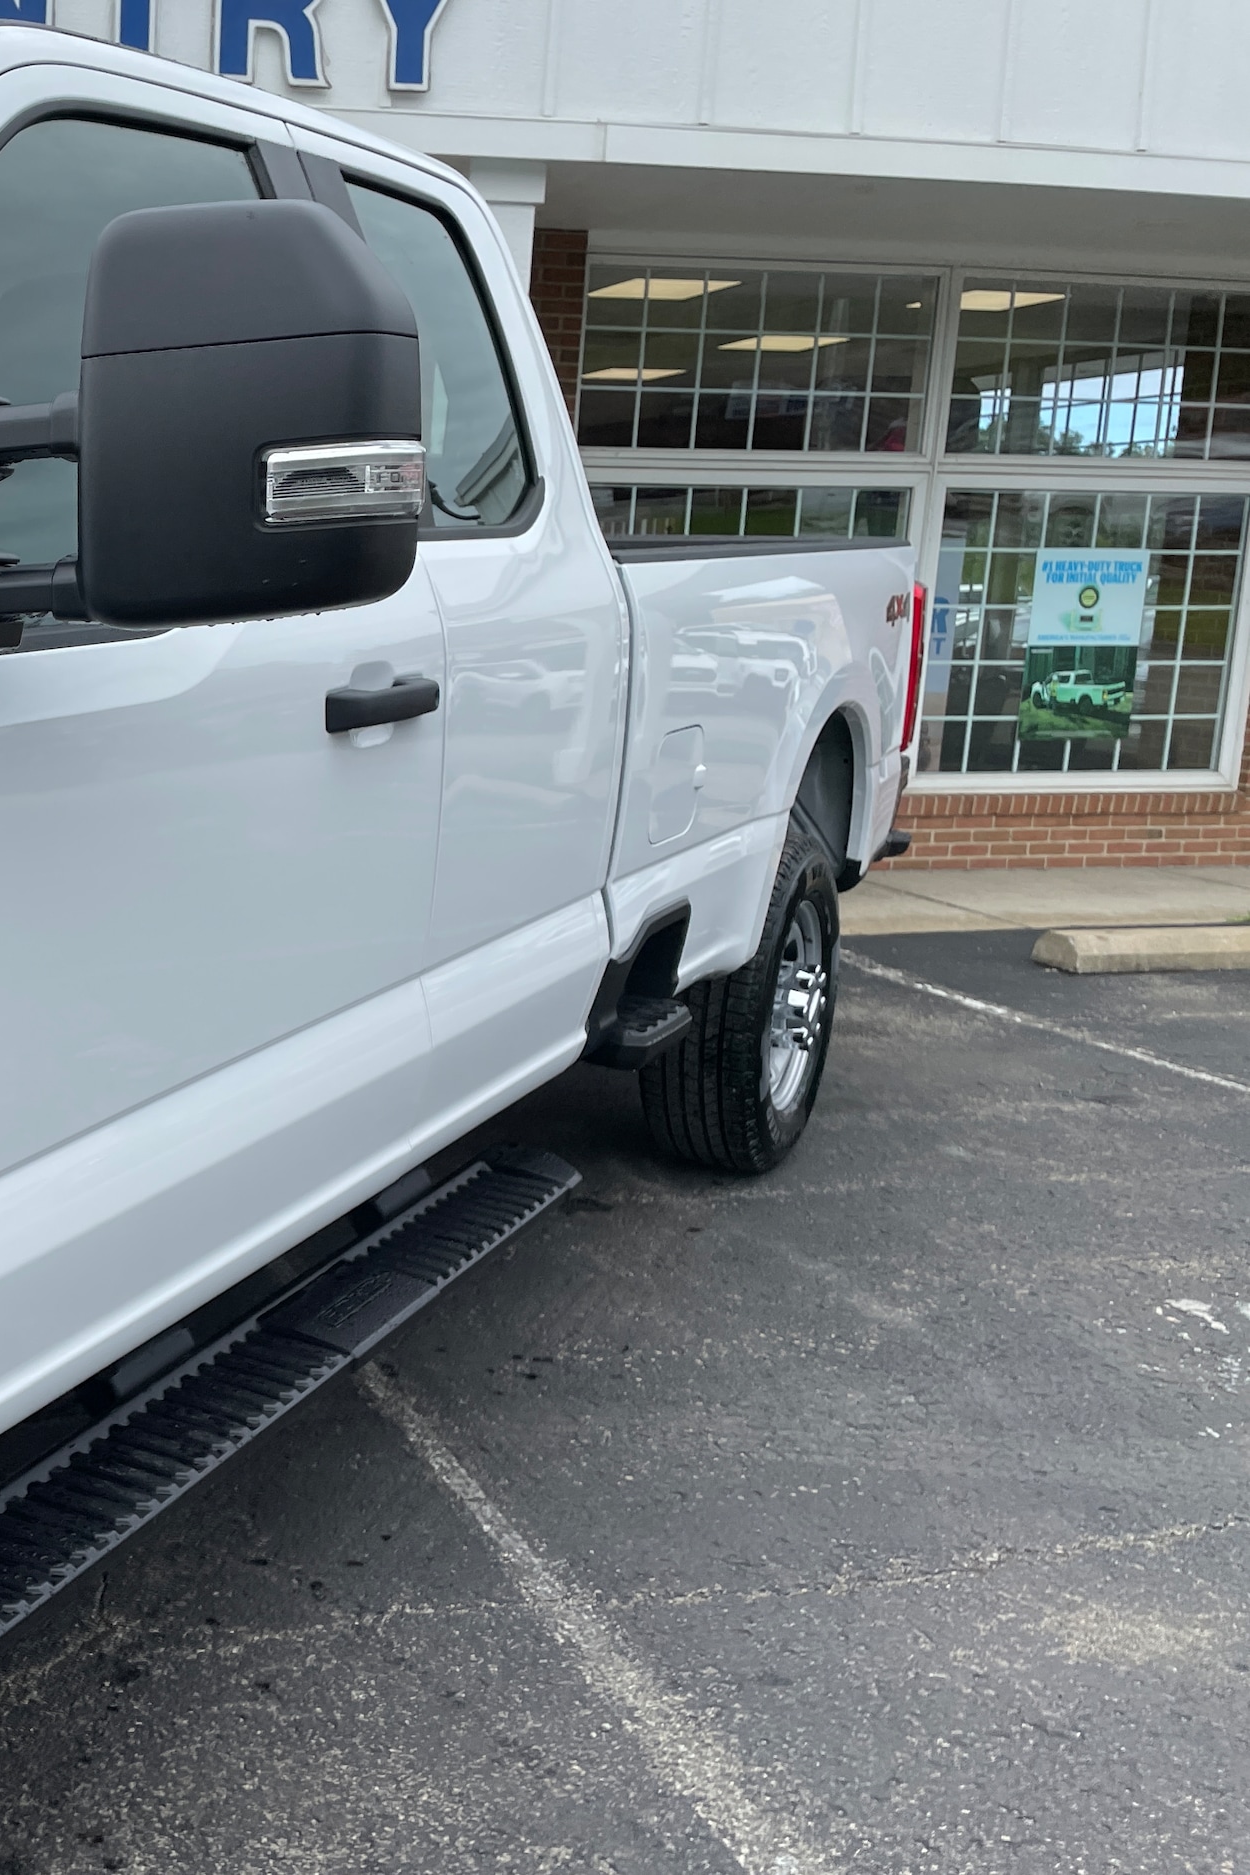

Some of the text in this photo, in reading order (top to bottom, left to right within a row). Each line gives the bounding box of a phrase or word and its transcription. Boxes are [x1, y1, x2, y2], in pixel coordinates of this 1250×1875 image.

[1042, 560, 1143, 573] #1 HEAVY-DUTY TRUCK
[1046, 572, 1137, 586] FOR INITIAL QUALITY
